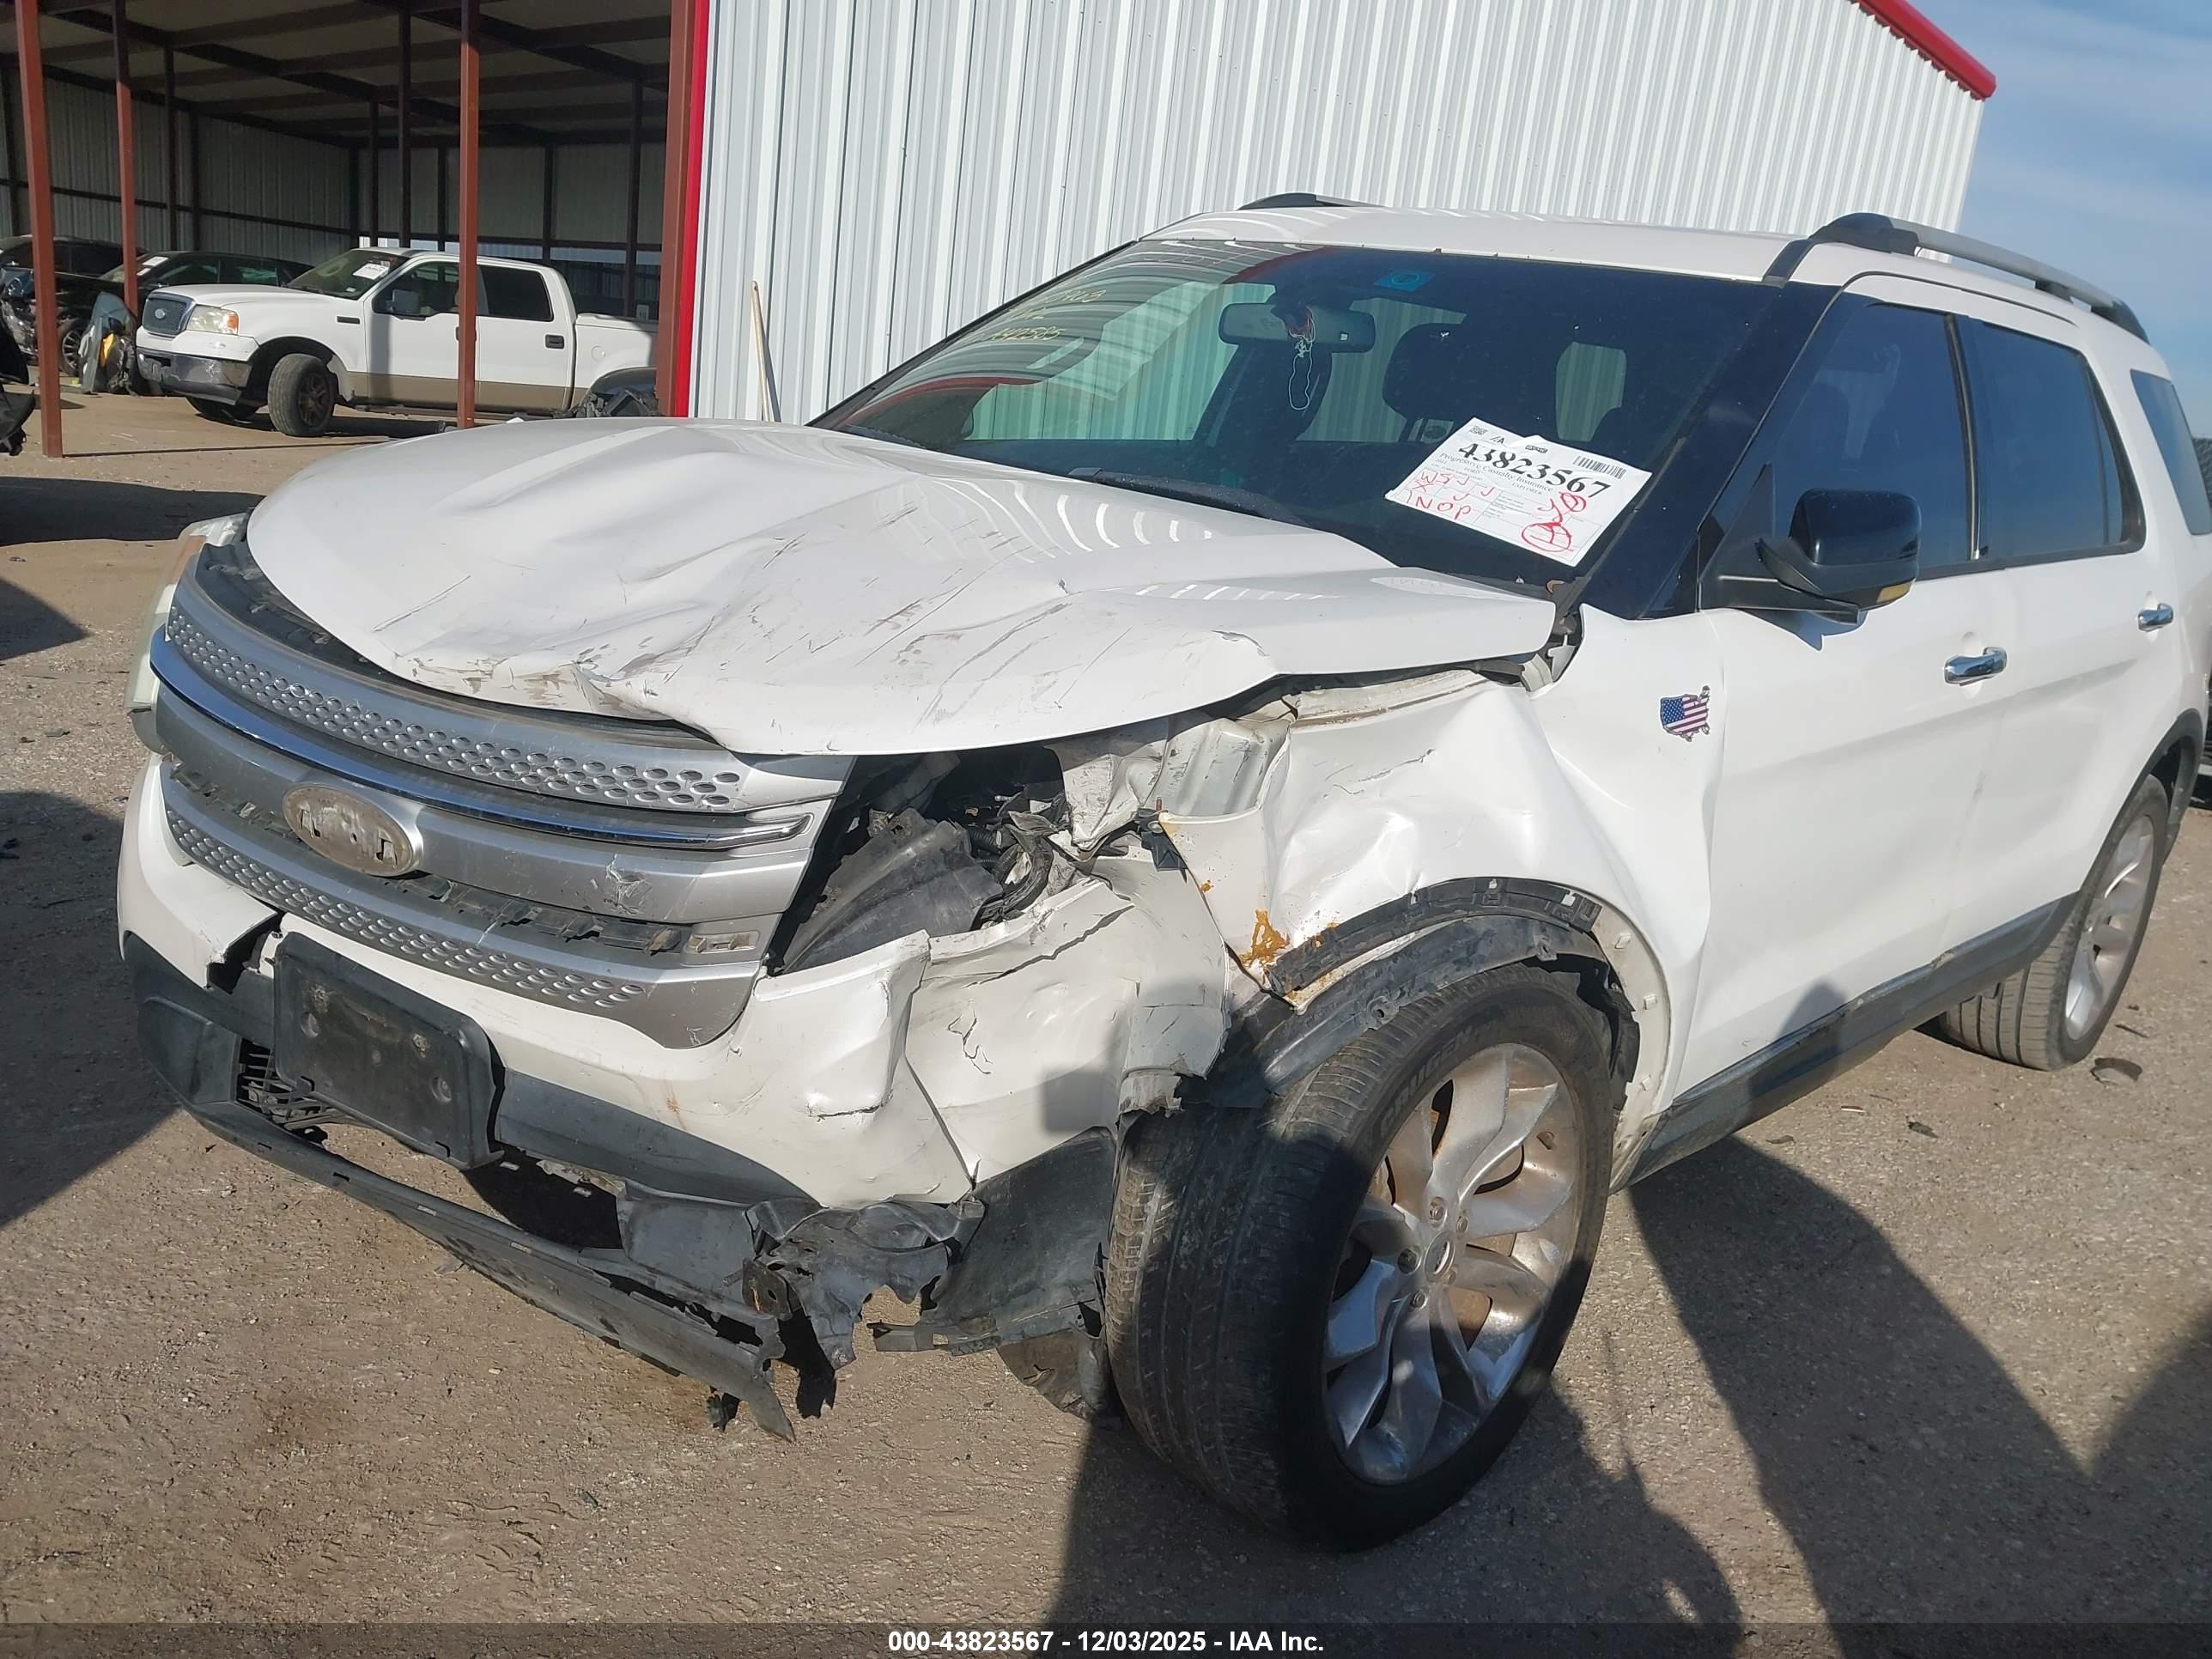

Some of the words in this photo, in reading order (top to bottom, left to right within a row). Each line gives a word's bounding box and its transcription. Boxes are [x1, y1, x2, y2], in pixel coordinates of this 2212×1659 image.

[1439, 453, 1482, 469] Progressive
[1483, 465, 1514, 480] Casualty
[1516, 475, 1553, 493] Insurance
[1458, 442, 1613, 499] 43823567
